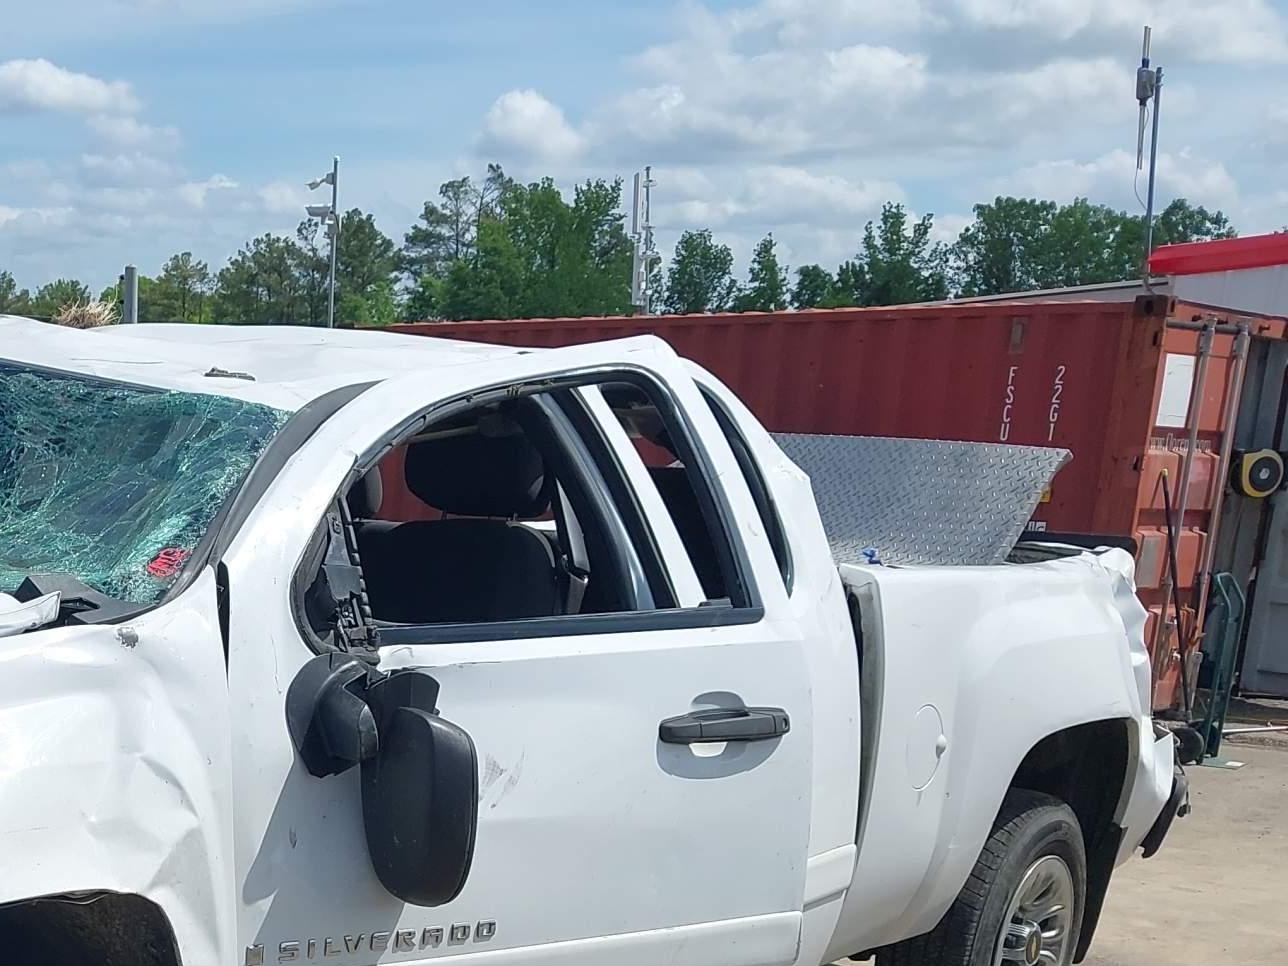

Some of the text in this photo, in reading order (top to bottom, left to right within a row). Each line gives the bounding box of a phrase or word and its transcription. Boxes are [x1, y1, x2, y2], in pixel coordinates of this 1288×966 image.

[1000, 366, 1019, 441] FSCU
[1048, 366, 1066, 441] 22G1
[278, 919, 496, 964] SILVERADO
